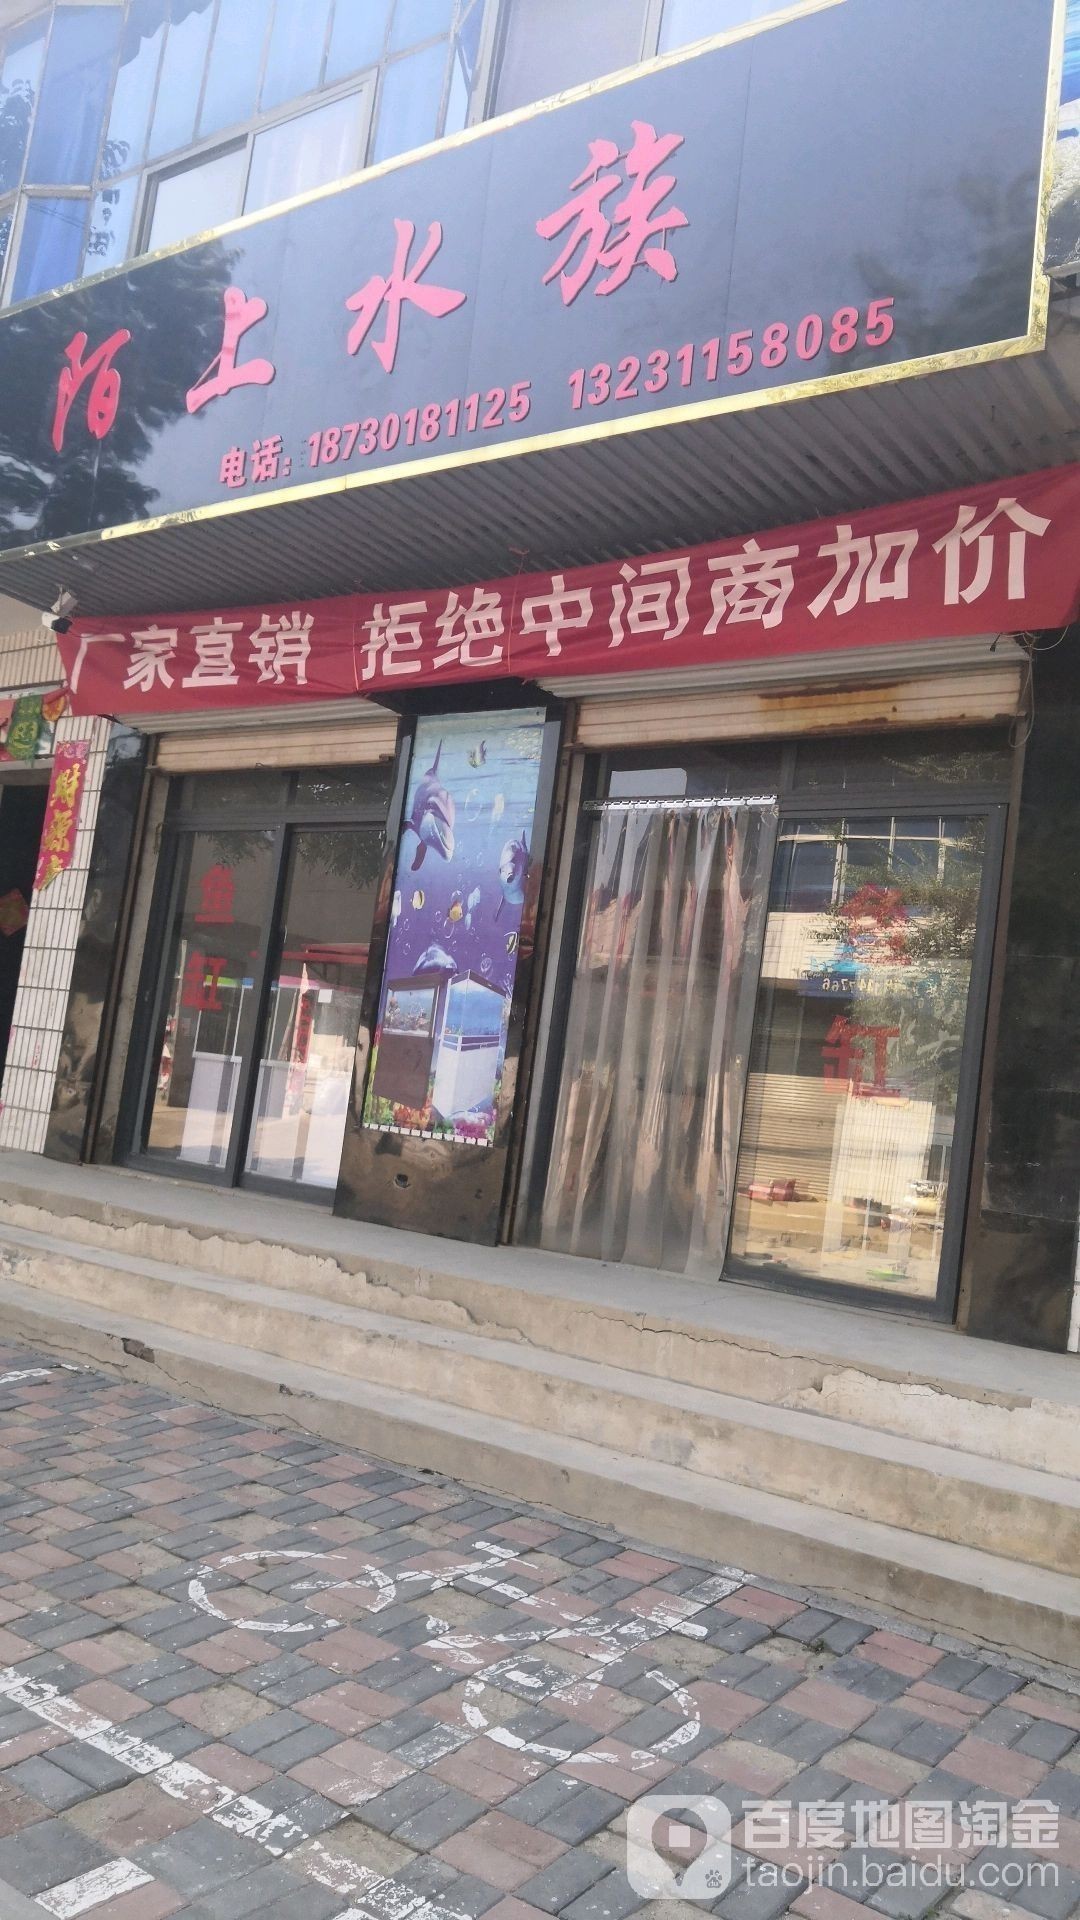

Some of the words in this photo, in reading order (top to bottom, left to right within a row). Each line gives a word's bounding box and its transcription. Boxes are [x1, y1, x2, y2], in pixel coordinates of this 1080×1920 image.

[52, 120, 690, 454] 陌上水族
[568, 297, 896, 410] 13231158085
[70, 611, 315, 694] 厂家直销
[361, 497, 1053, 681] 拒绝中间商加价
